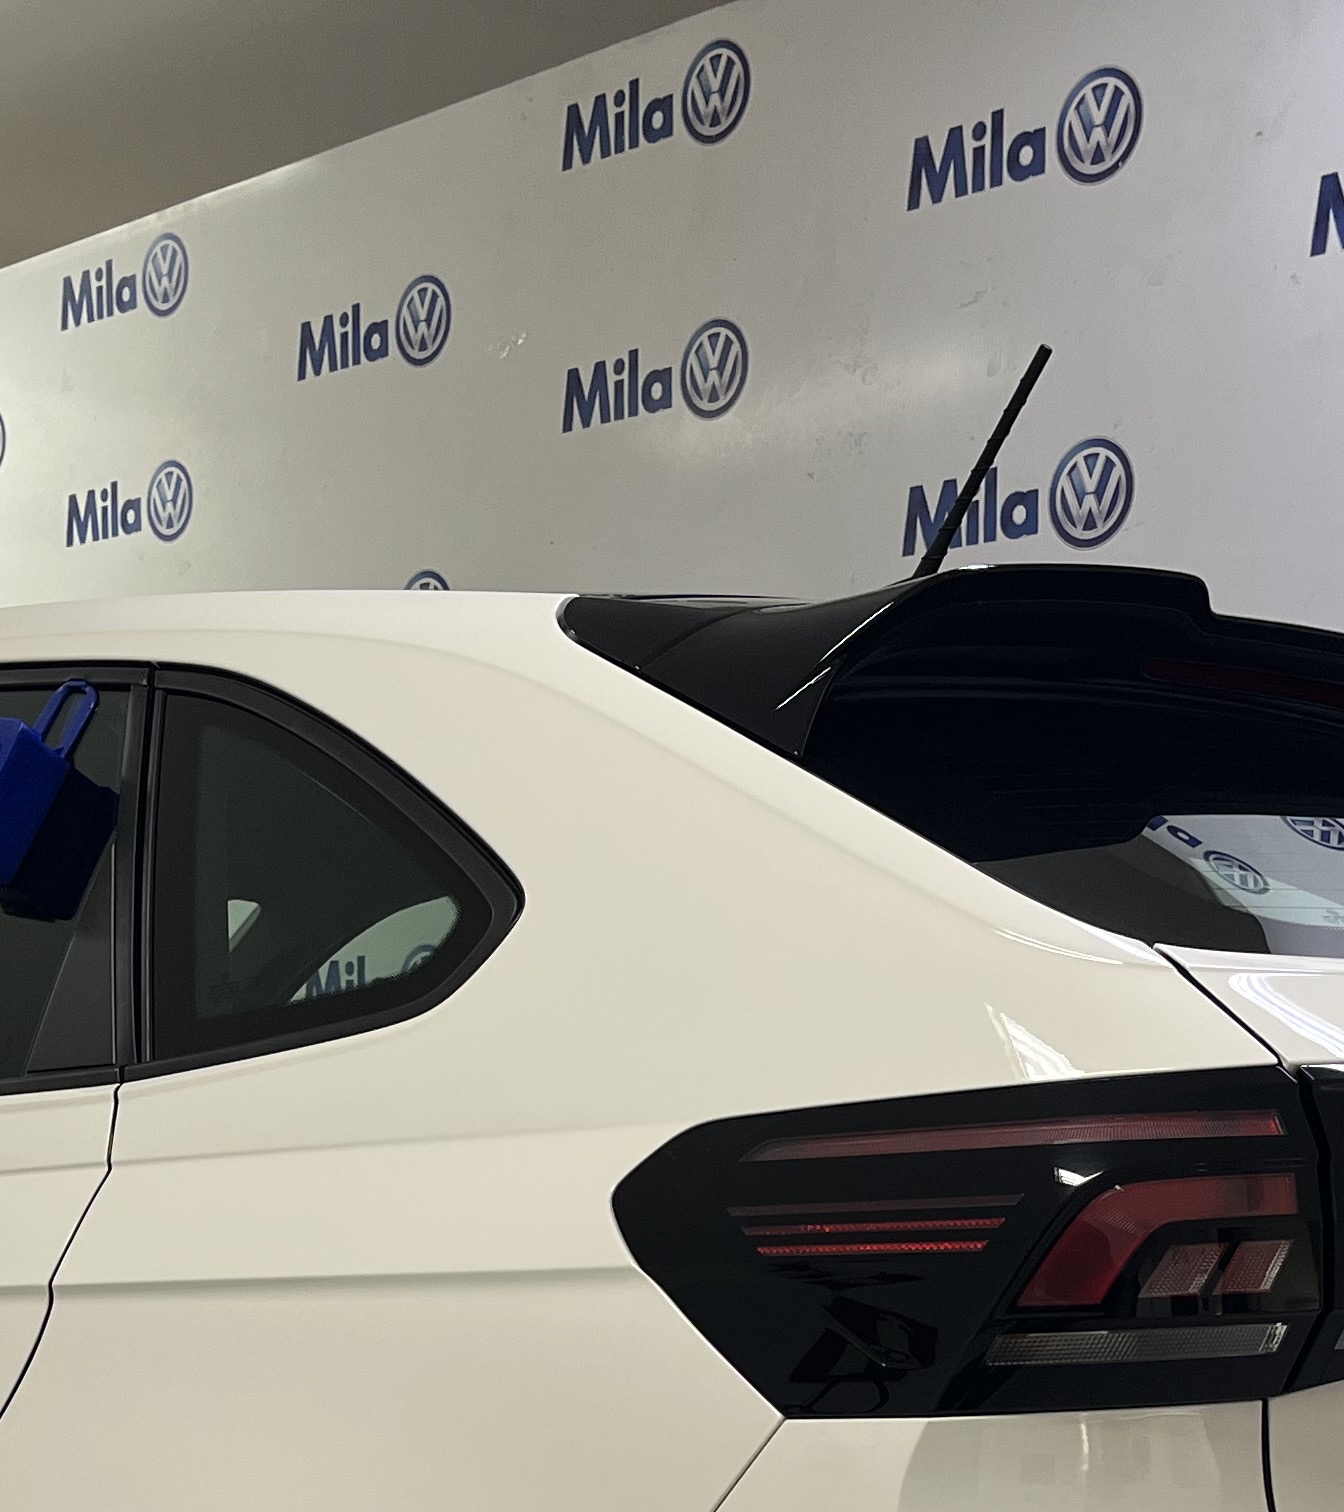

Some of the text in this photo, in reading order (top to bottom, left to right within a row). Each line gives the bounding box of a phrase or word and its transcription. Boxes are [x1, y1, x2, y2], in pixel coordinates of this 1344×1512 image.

[562, 78, 674, 171] Mila
[907, 109, 1047, 211] Mila
[61, 259, 138, 331] Mila
[298, 303, 389, 381] Mila
[562, 348, 673, 433] Mila
[66, 481, 142, 547] Mila
[902, 467, 1039, 557] Mila
[306, 955, 367, 996] Mil
